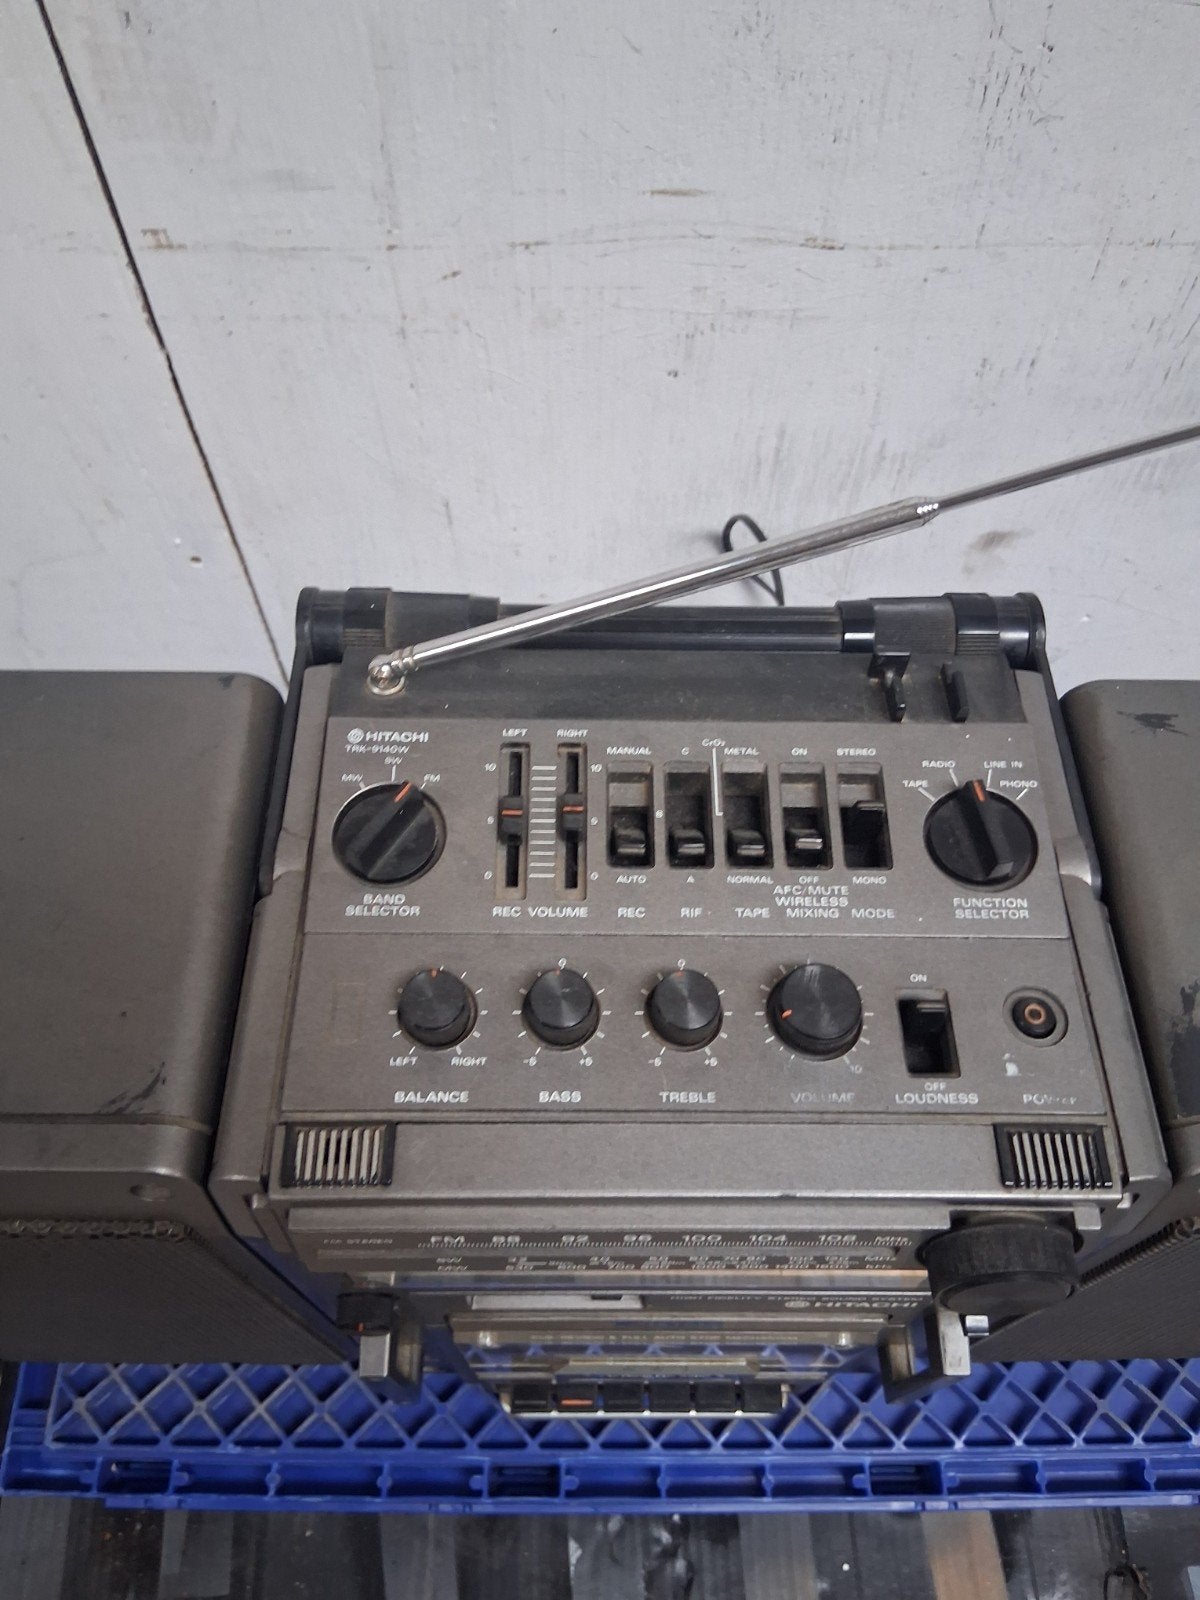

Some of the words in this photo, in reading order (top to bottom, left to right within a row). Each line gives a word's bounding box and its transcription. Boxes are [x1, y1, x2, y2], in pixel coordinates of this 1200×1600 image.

[365, 731, 429, 743] HITACHI
[502, 728, 528, 737] LEFT
[556, 728, 589, 738] RIGHT
[606, 746, 652, 755] MANUAL
[724, 747, 760, 756] METAL
[791, 747, 808, 756] ON
[836, 748, 876, 756] STEREO
[485, 763, 497, 772] 10
[590, 763, 602, 773] 10
[922, 760, 956, 769] RADIO
[984, 760, 1007, 769] LINE
[1010, 760, 1023, 769] IN
[341, 773, 364, 783] MW
[423, 773, 441, 783] FM
[902, 779, 928, 788] TAPE
[999, 780, 1038, 788] PHONO
[616, 875, 647, 884] AUTO
[686, 875, 695, 884] A
[727, 876, 774, 884] NORMAL
[799, 876, 820, 885] OFF
[852, 876, 887, 885] MONO
[773, 885, 850, 896] AFC/MUTE
[362, 894, 406, 905] BAND
[775, 896, 849, 907] WIRELESS
[953, 898, 1028, 908] FUNCTION
[345, 905, 421, 917] SELECTOR
[492, 906, 522, 918] REC
[528, 906, 589, 918] VOLUME
[617, 907, 646, 918] REC
[735, 907, 770, 918] TAPE
[786, 907, 840, 919] MIXING
[851, 908, 895, 919] MODE
[955, 908, 1029, 919] SELECTOR
[910, 973, 927, 983] ON
[389, 1056, 418, 1067] LEFT
[451, 1056, 488, 1067] RIGHT
[924, 1082, 947, 1092] OFF
[394, 1090, 469, 1103] BALANCE
[538, 1090, 582, 1103] BASS
[659, 1091, 717, 1103] TREBLE
[895, 1092, 979, 1105] LOUDNESS
[430, 1235, 466, 1245] FM
[682, 1234, 722, 1243] 100
[749, 1234, 788, 1243] 104
[819, 1234, 857, 1243] 108
